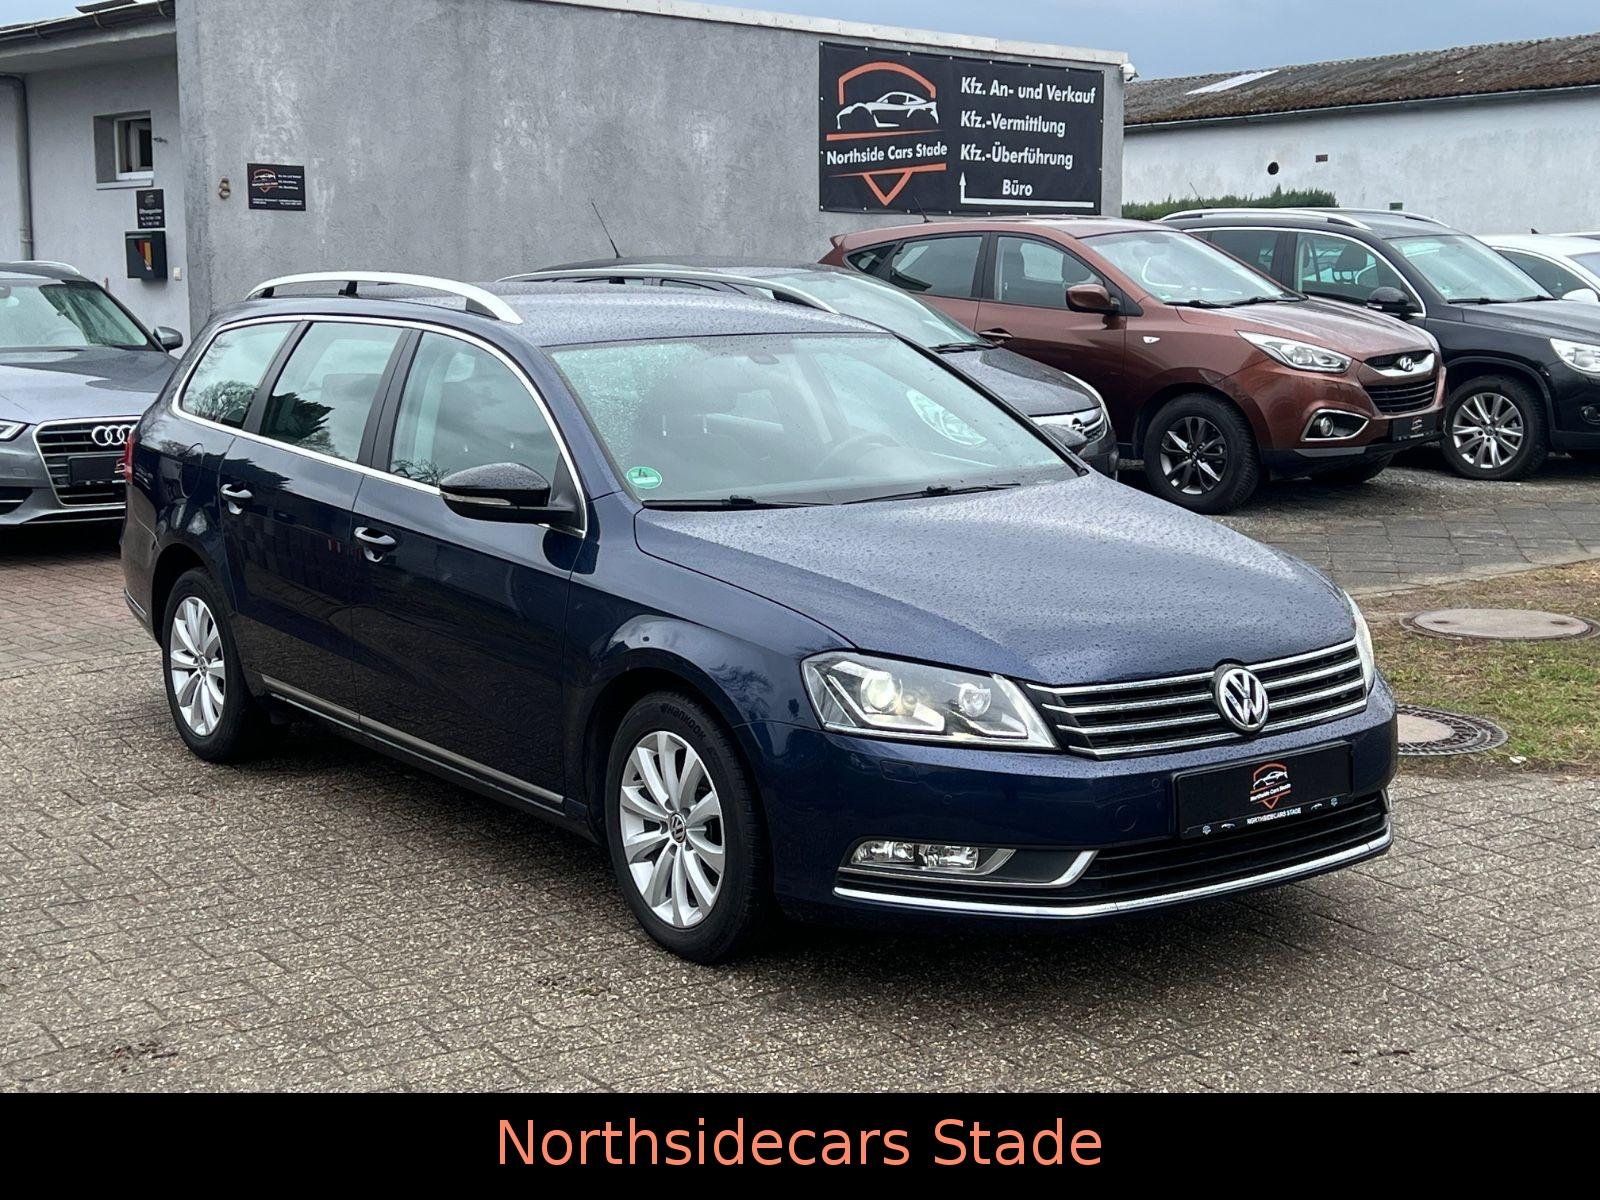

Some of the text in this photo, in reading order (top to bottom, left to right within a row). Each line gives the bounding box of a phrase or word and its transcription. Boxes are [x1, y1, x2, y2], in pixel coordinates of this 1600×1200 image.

[960, 76, 1096, 104] Kfz. An- und Verkauf
[960, 110, 1066, 138] Kfz.-Vermittlung
[826, 141, 948, 166] Northside Cars Stade
[960, 142, 1074, 170] Kfz.-Überführung
[1002, 179, 1033, 197] Büro
